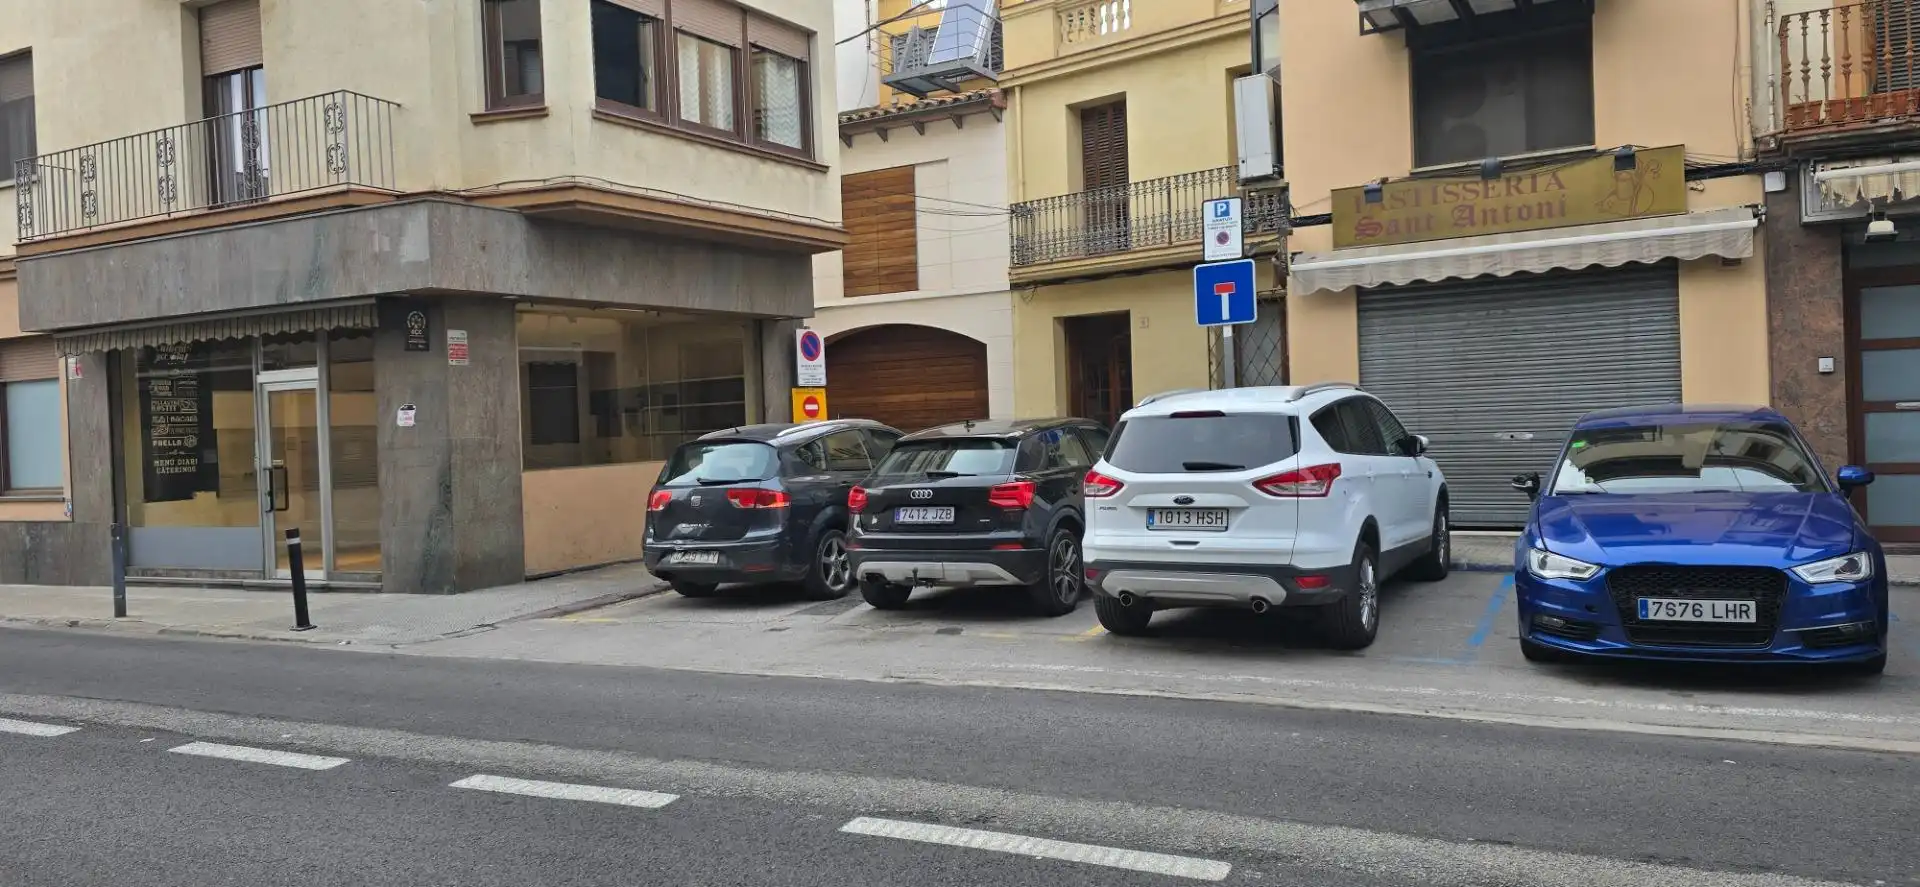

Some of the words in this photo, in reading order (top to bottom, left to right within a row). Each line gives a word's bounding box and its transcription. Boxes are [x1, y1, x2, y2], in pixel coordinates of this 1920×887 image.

[1354, 213, 1434, 240] Sant
[1451, 194, 1567, 228] Antoni
[902, 508, 929, 520] 7412
[931, 508, 953, 520] JZB
[1158, 511, 1192, 525] 1013
[1196, 511, 1224, 525] HSH
[1711, 603, 1751, 619] LHR
